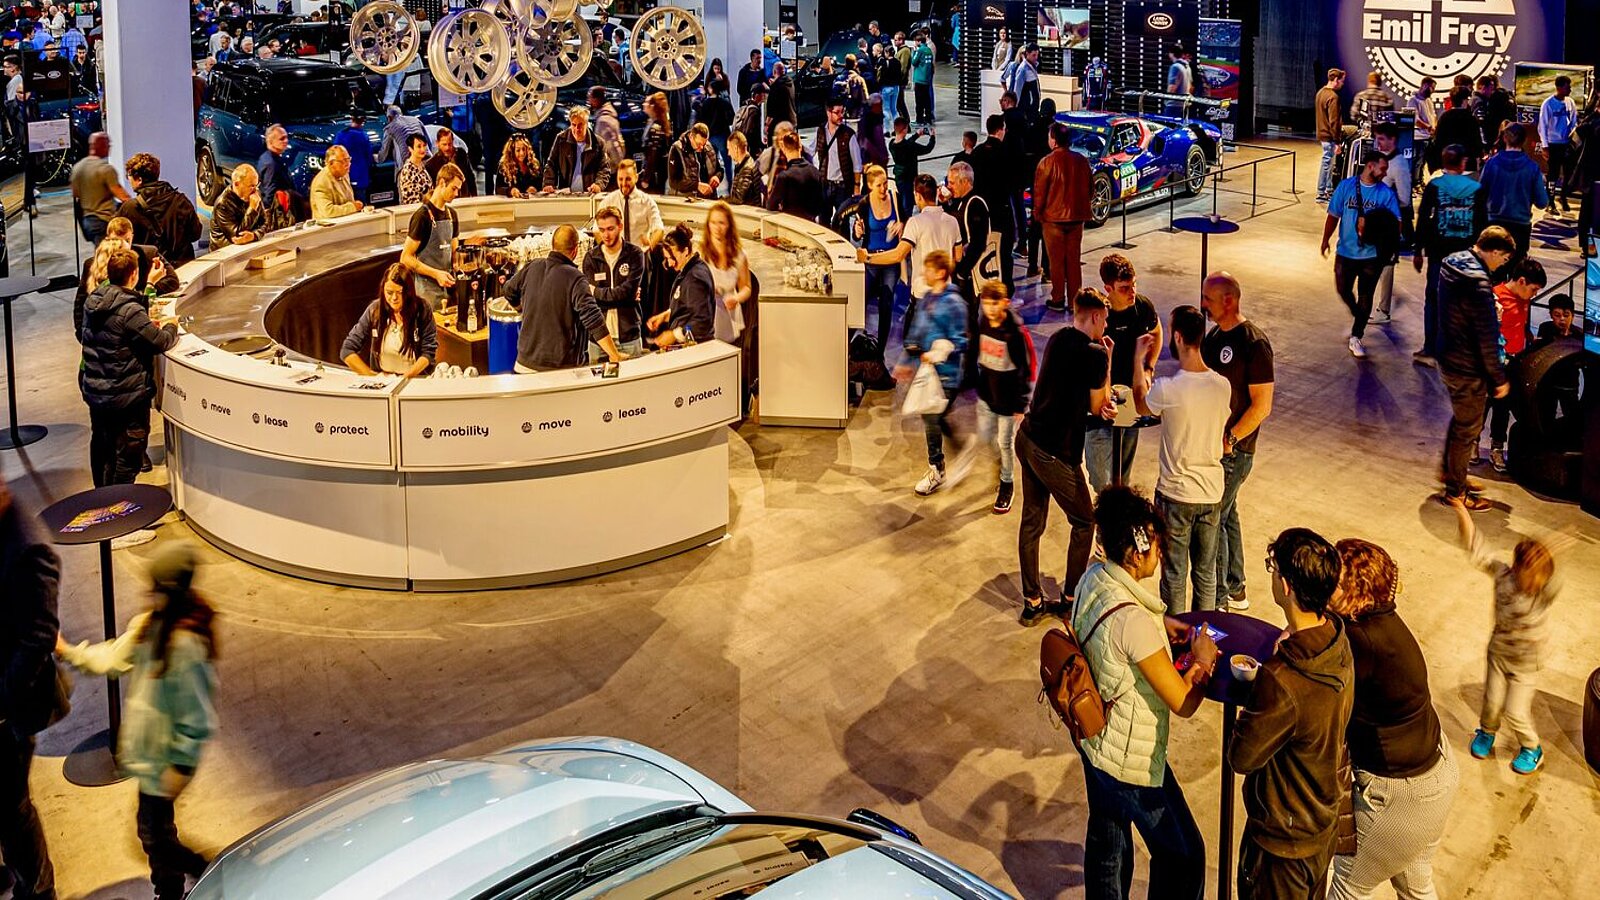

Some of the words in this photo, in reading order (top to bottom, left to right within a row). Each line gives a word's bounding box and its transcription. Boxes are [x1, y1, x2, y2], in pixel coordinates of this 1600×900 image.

[1362, 12, 1432, 43] Emil
[1440, 16, 1517, 54] Frey
[210, 403, 231, 416] move
[264, 414, 289, 428] lease
[329, 423, 369, 436] protect
[439, 424, 490, 438] mobility
[538, 417, 572, 431] move
[618, 405, 647, 420] lease
[688, 386, 722, 406] protect
